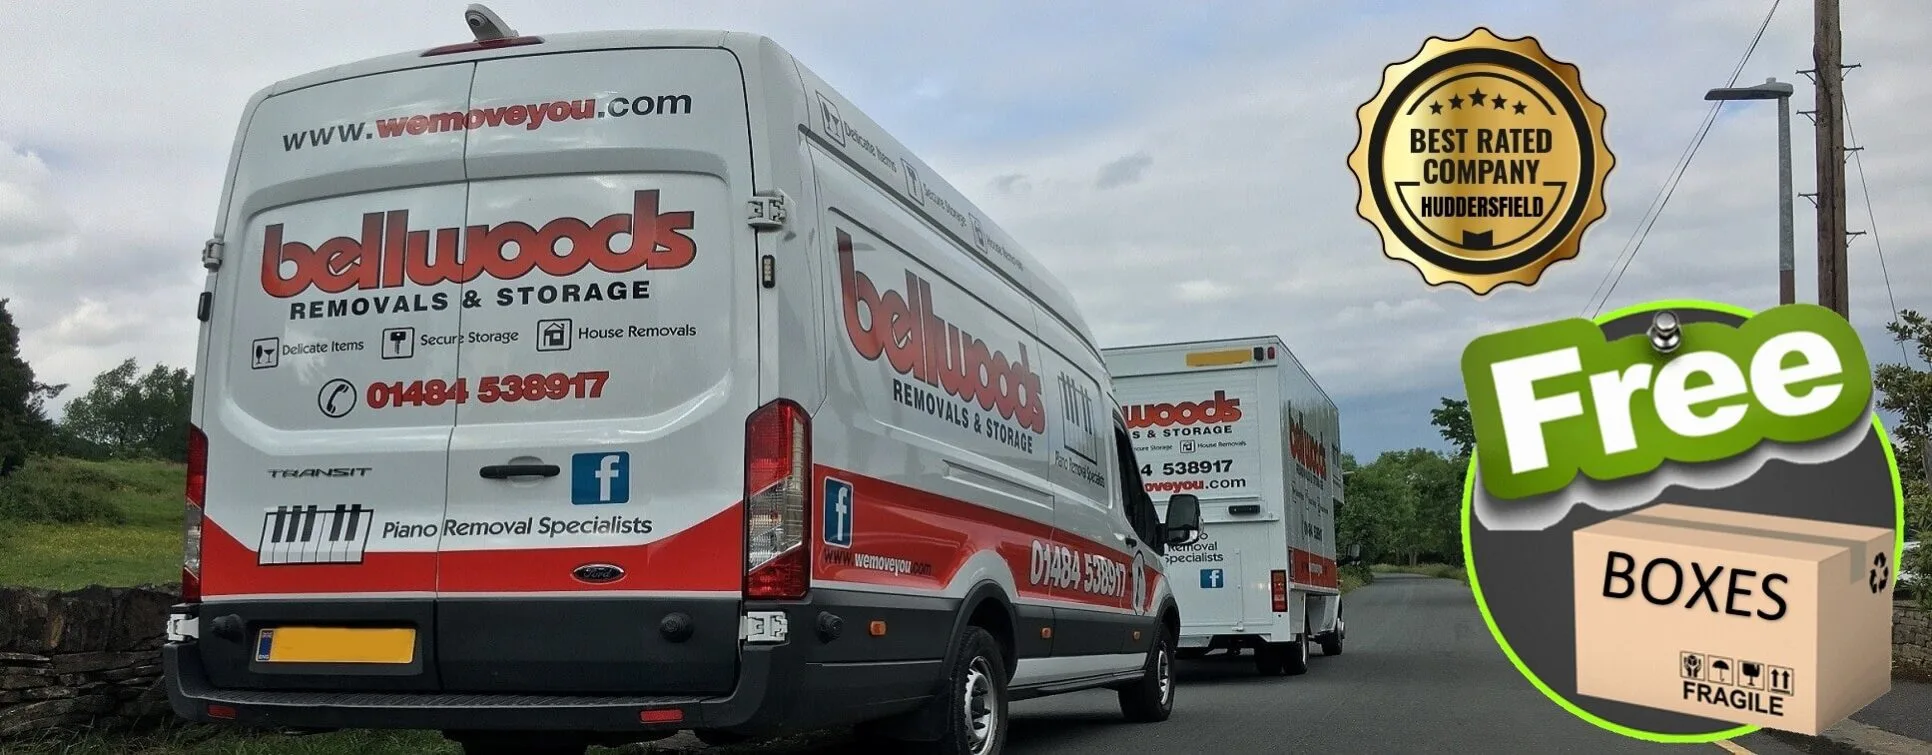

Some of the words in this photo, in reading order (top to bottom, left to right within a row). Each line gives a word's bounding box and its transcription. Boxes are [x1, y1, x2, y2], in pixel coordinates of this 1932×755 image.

[282, 93, 692, 152] www.wemoveyou.com
[261, 189, 697, 298] bellwoods
[289, 290, 448, 320] REMOVALS
[461, 291, 482, 309] &
[496, 281, 650, 307] STORAGE
[420, 331, 465, 347] Secure
[468, 329, 519, 347] Storage
[577, 325, 624, 339] House
[628, 323, 697, 338] Removals
[836, 227, 1047, 435] bellwoods
[282, 340, 330, 356] Delicate
[331, 338, 364, 352] Items
[366, 379, 468, 410] 01484
[478, 371, 610, 404] 538917
[893, 378, 968, 429] REMOVALS
[974, 414, 983, 434] &
[986, 420, 1034, 455] STORAGE
[1121, 390, 1242, 429] woods
[1163, 425, 1232, 437] STORAGE
[1218, 440, 1247, 449] Removals
[267, 467, 373, 479] TRANSIT
[1163, 459, 1233, 476] 538917
[1144, 477, 1246, 493] oveyou.com
[382, 521, 438, 539] Piano
[443, 516, 532, 537] Removal
[538, 514, 653, 537] Specialists
[823, 547, 932, 577] www.wemoveyou.com
[1030, 538, 1081, 590] 01484
[1083, 552, 1126, 597] 538917
